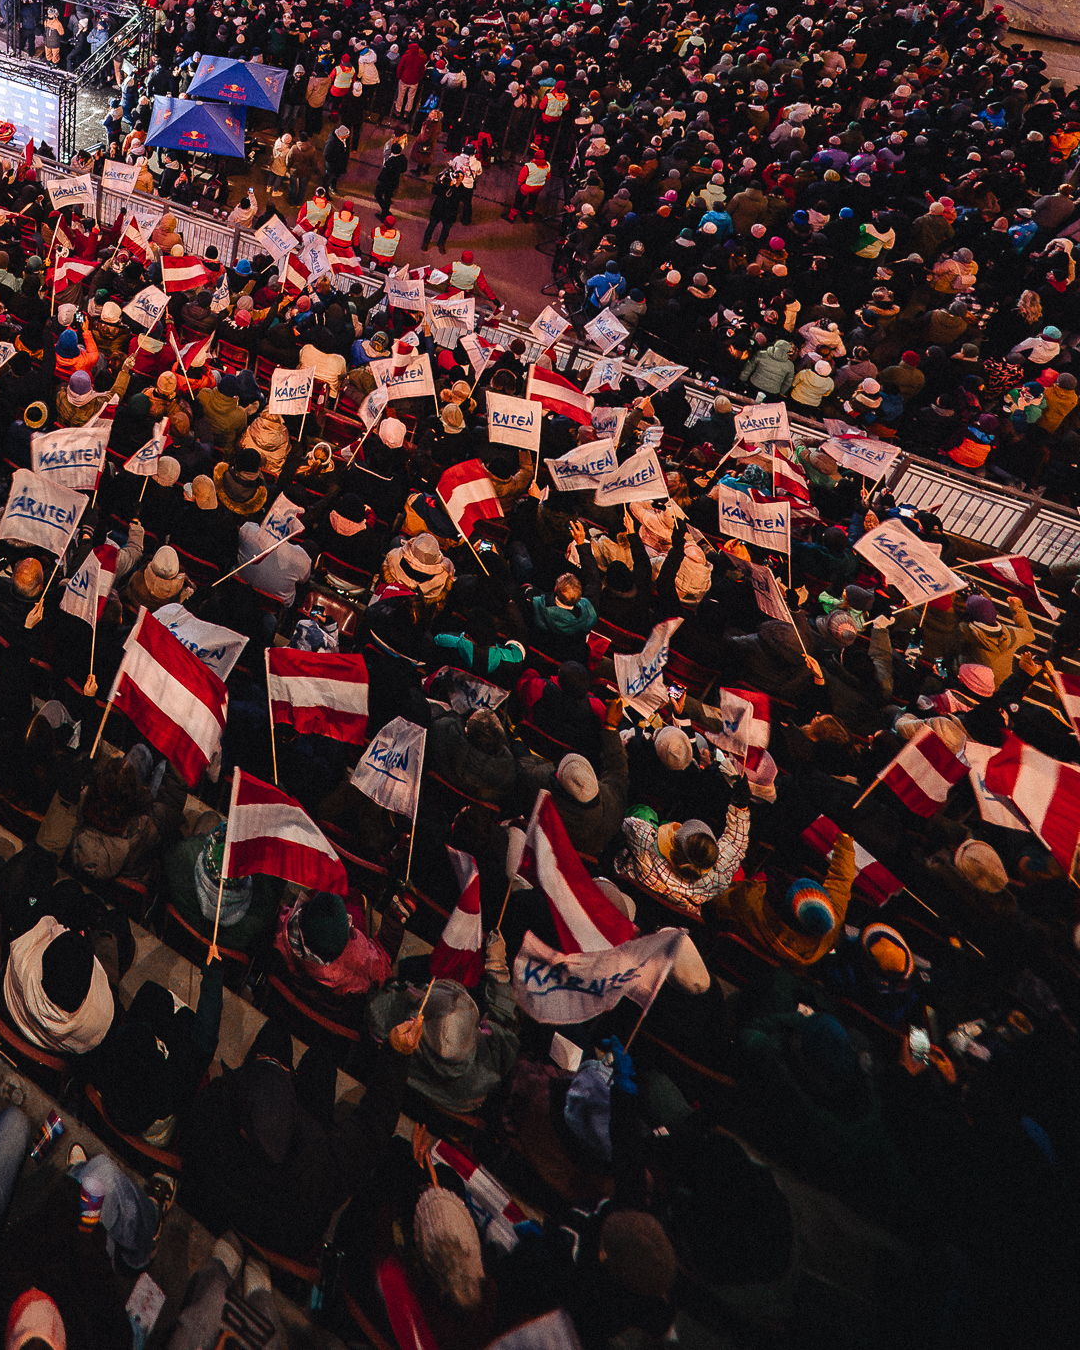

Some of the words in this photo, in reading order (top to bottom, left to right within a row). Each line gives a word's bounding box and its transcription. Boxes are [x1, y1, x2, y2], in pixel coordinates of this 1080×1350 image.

[233, 91, 247, 101] Bull
[104, 168, 135, 180] KÄRNTEN
[53, 183, 87, 198] KÄRNTEN
[264, 225, 291, 250] KÄRNTEN
[432, 305, 469, 317] KÄRNTEN
[739, 412, 782, 430] KÄRNTEN
[40, 441, 102, 467] KÄRNTEN
[553, 450, 613, 476] KÄRNTEN
[602, 459, 656, 492] KÄRNTEN
